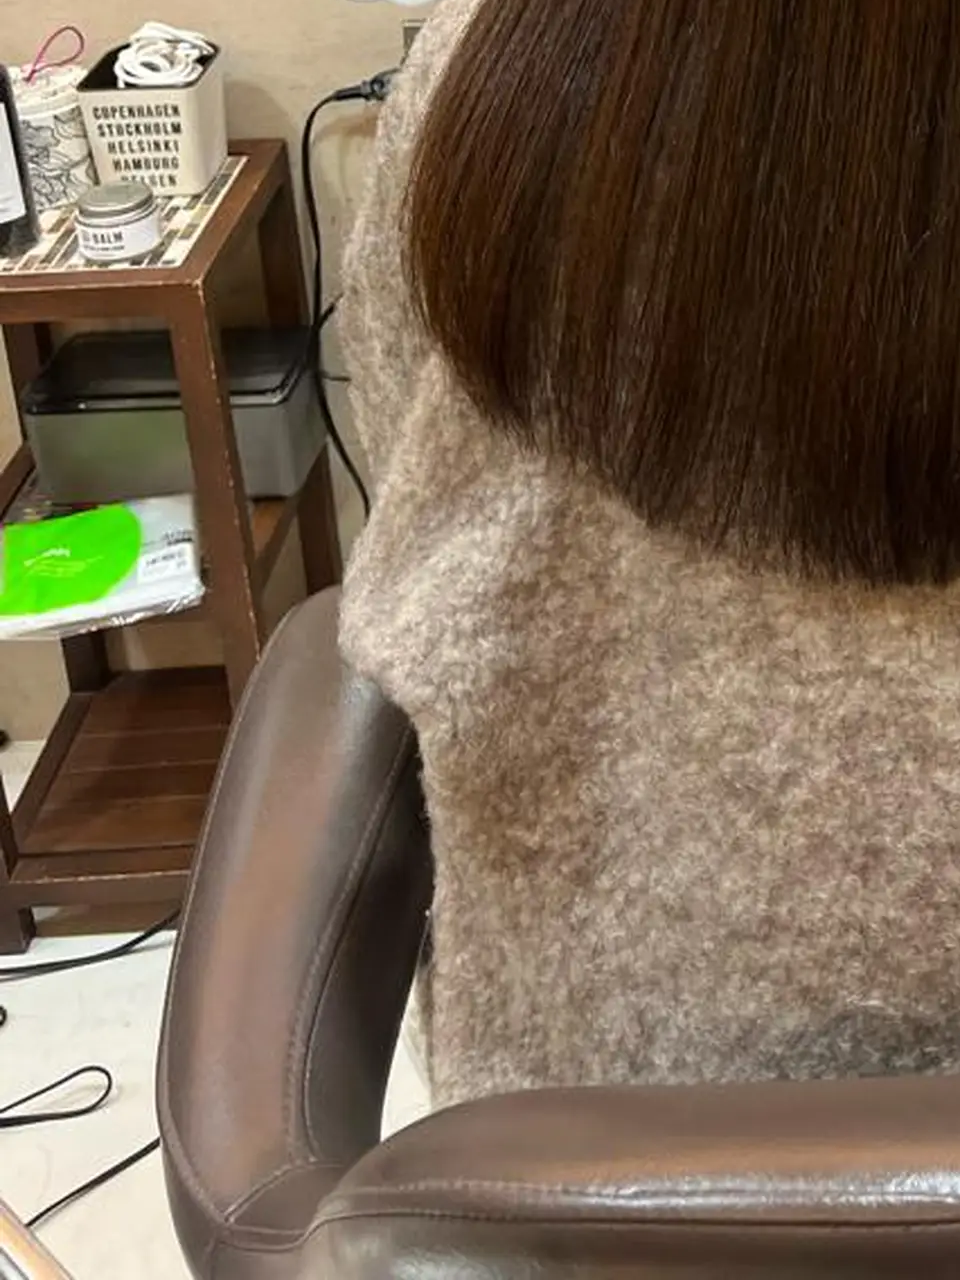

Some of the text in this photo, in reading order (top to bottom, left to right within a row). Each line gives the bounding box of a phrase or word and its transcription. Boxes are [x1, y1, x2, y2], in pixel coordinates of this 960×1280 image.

[93, 105, 179, 120] COPENHAGEN
[97, 122, 182, 137] STOCKHOLM
[108, 140, 179, 153] HELSINKI
[112, 157, 179, 171] HAMBURG
